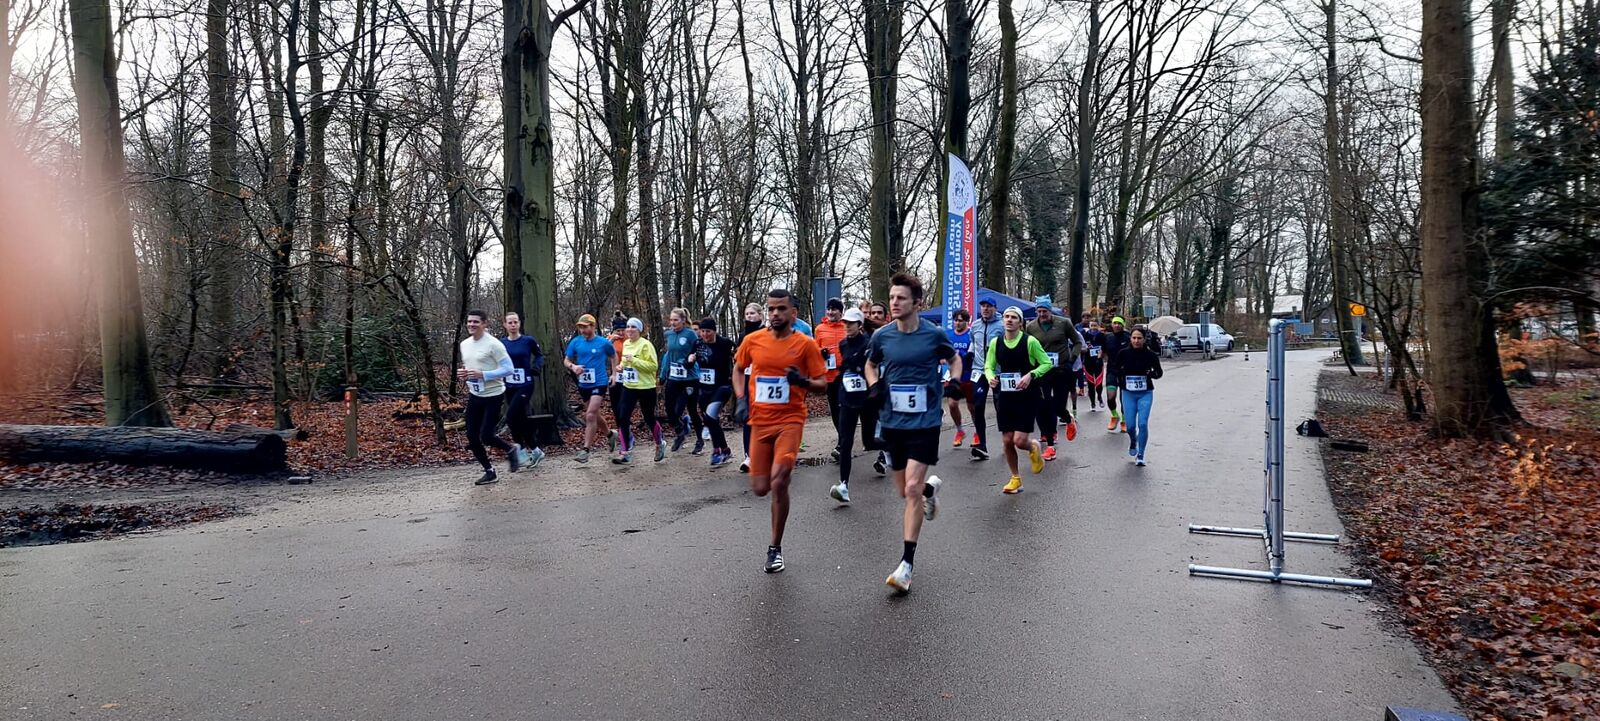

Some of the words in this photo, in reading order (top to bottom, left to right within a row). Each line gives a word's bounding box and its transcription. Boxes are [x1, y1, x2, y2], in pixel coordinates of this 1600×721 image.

[582, 373, 592, 381] 24
[703, 374, 711, 382] 35
[851, 378, 861, 389] 36
[1008, 379, 1017, 389] 18
[1134, 381, 1143, 389] 39
[767, 386, 783, 399] 25
[908, 395, 916, 408] 5
